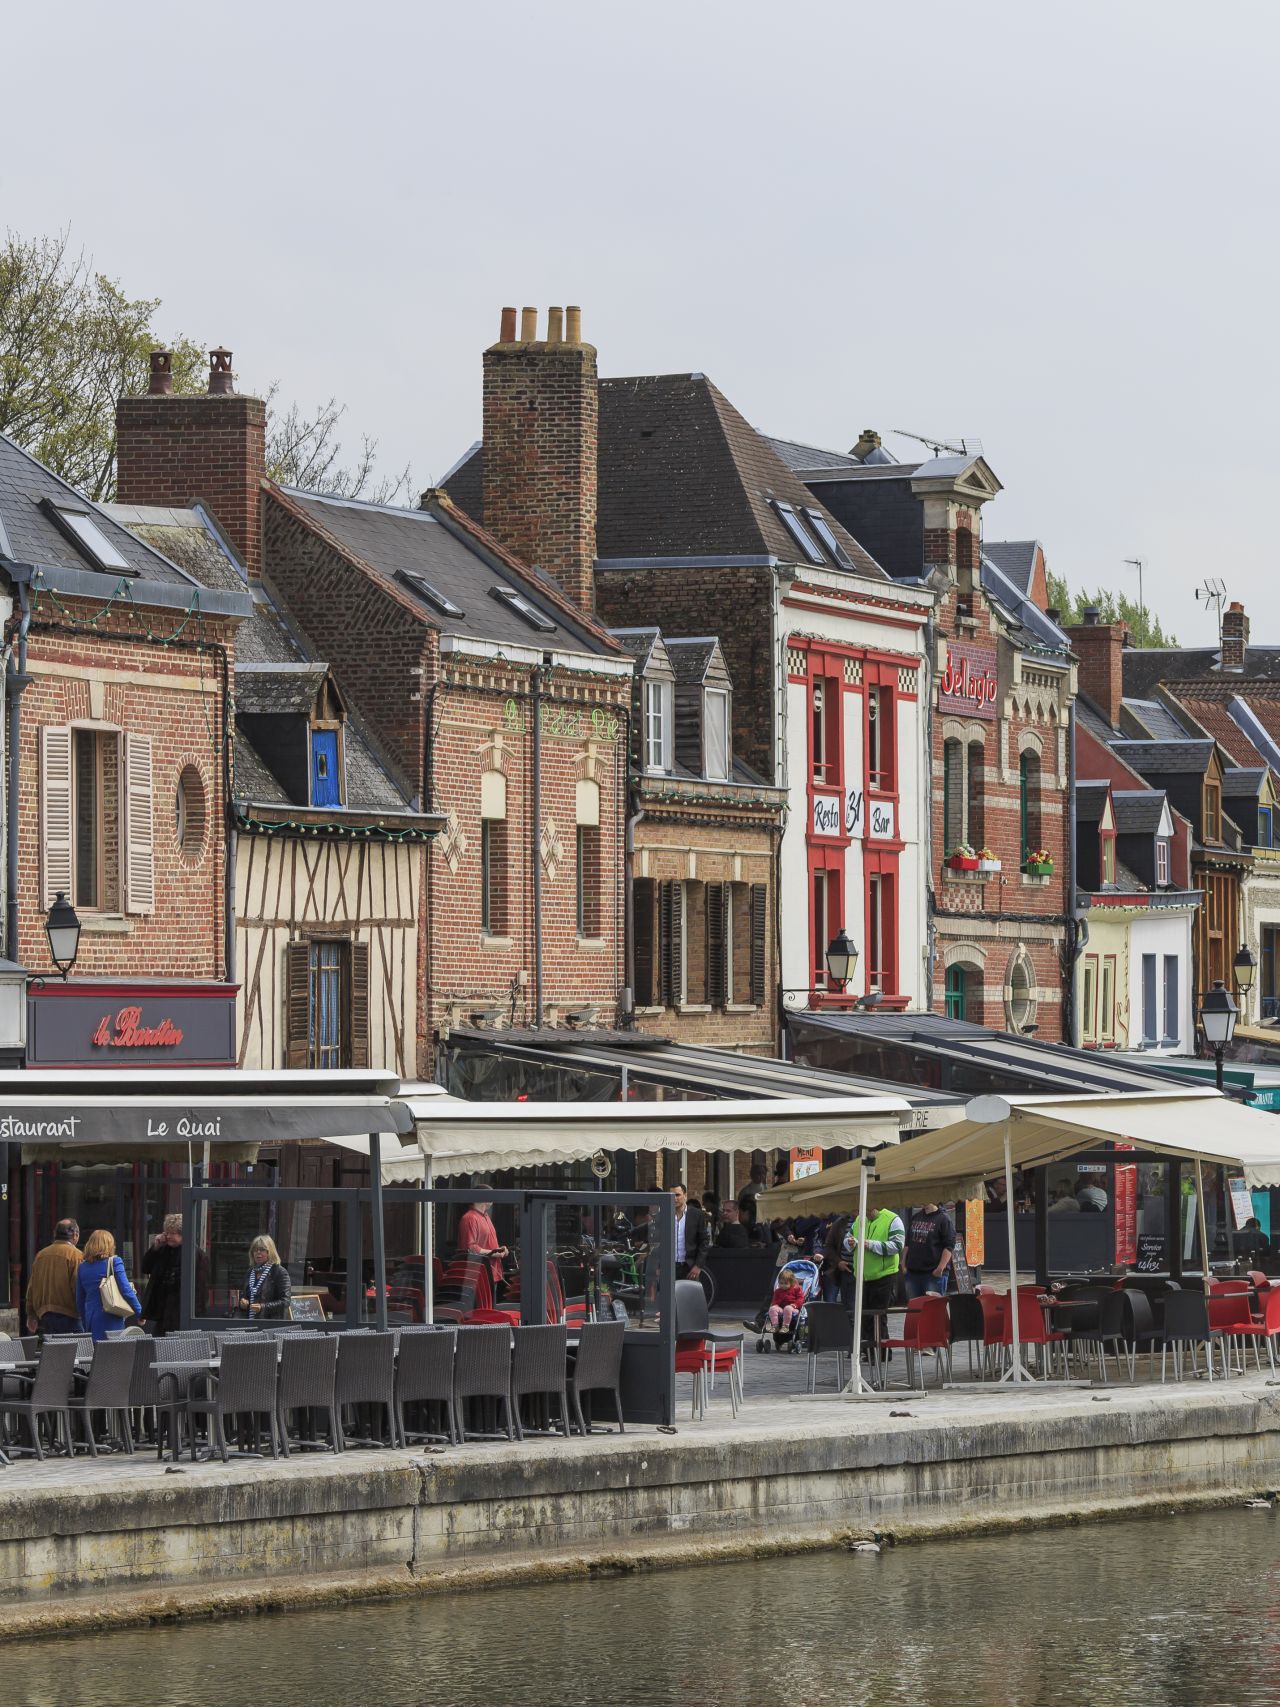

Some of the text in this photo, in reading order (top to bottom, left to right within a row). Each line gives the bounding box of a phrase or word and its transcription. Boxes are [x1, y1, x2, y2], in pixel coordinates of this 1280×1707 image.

[814, 800, 839, 831] Resto
[846, 790, 863, 833] 31
[872, 807, 891, 833] Bar
[0, 1115, 222, 1138] staurant Le Quai
